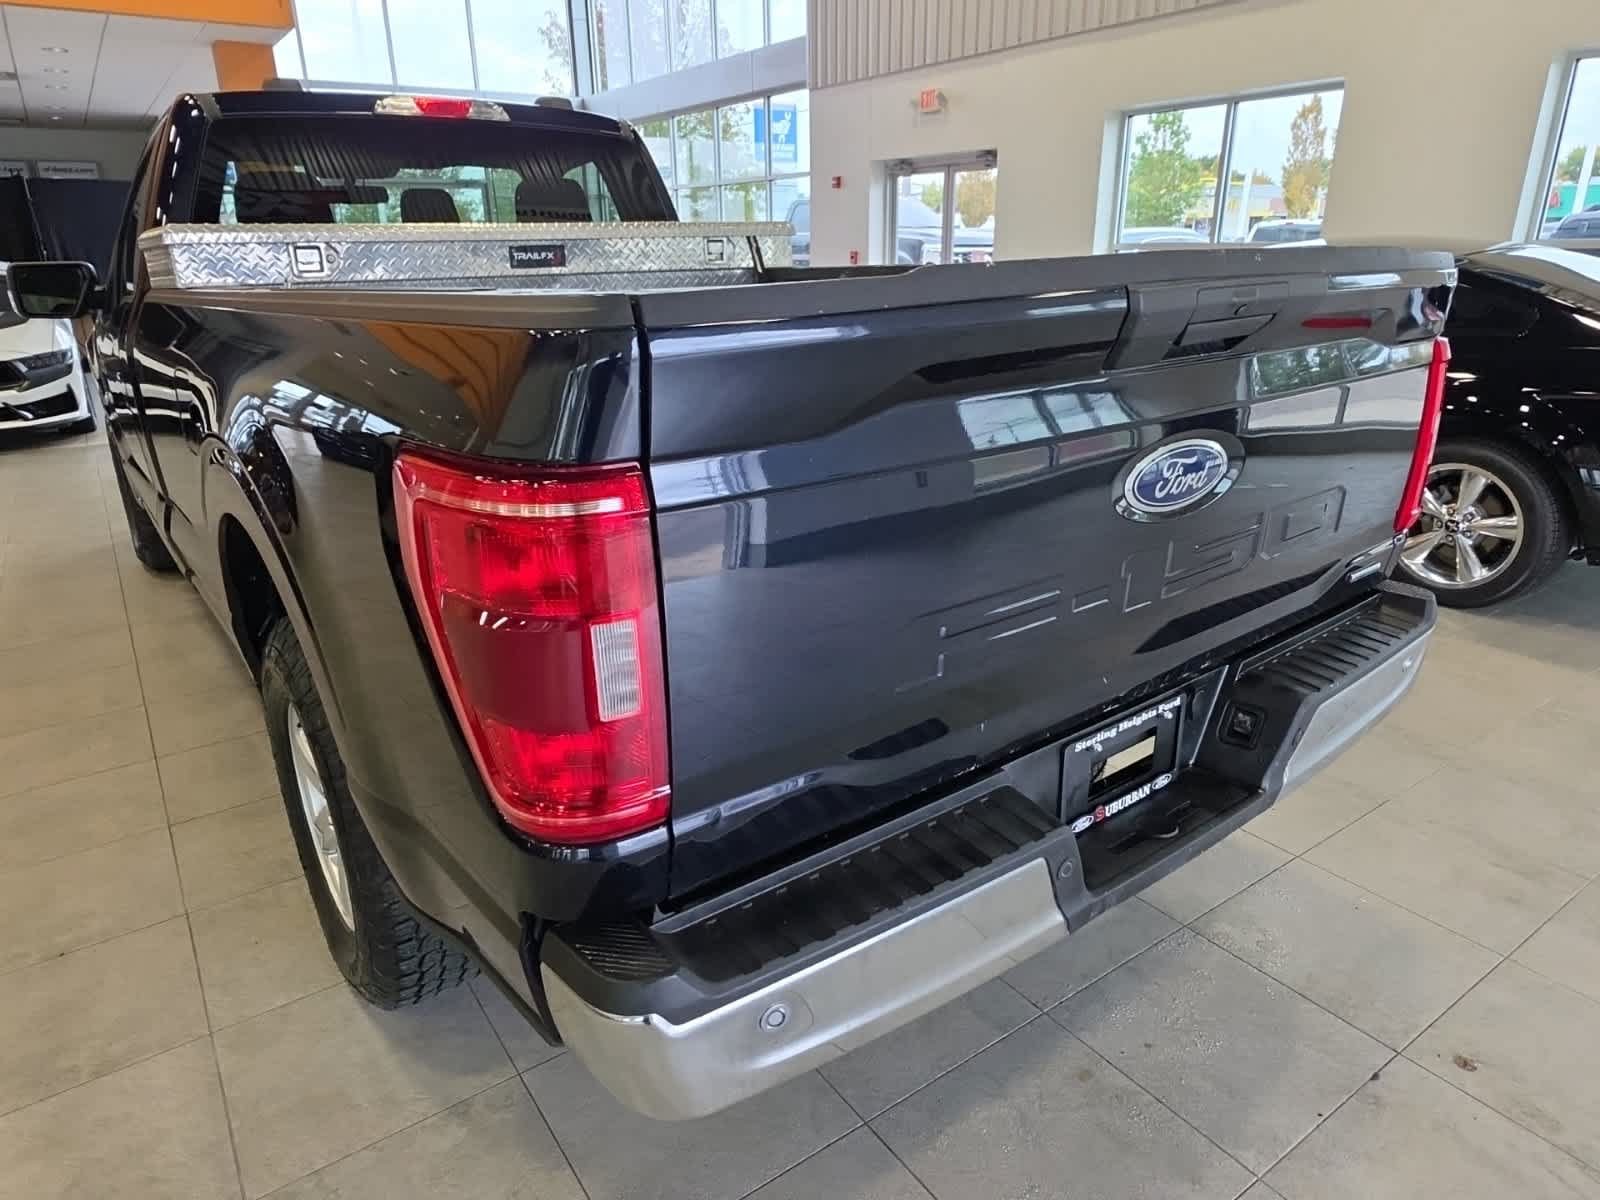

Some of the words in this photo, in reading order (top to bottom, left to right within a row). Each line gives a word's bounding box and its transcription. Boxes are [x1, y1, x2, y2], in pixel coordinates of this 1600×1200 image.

[1154, 455, 1209, 499] Ford
[1075, 726, 1117, 752] Sterling
[1118, 709, 1157, 732] Heights
[1157, 696, 1182, 714] Ford
[1094, 783, 1152, 822] SUBURBAN
